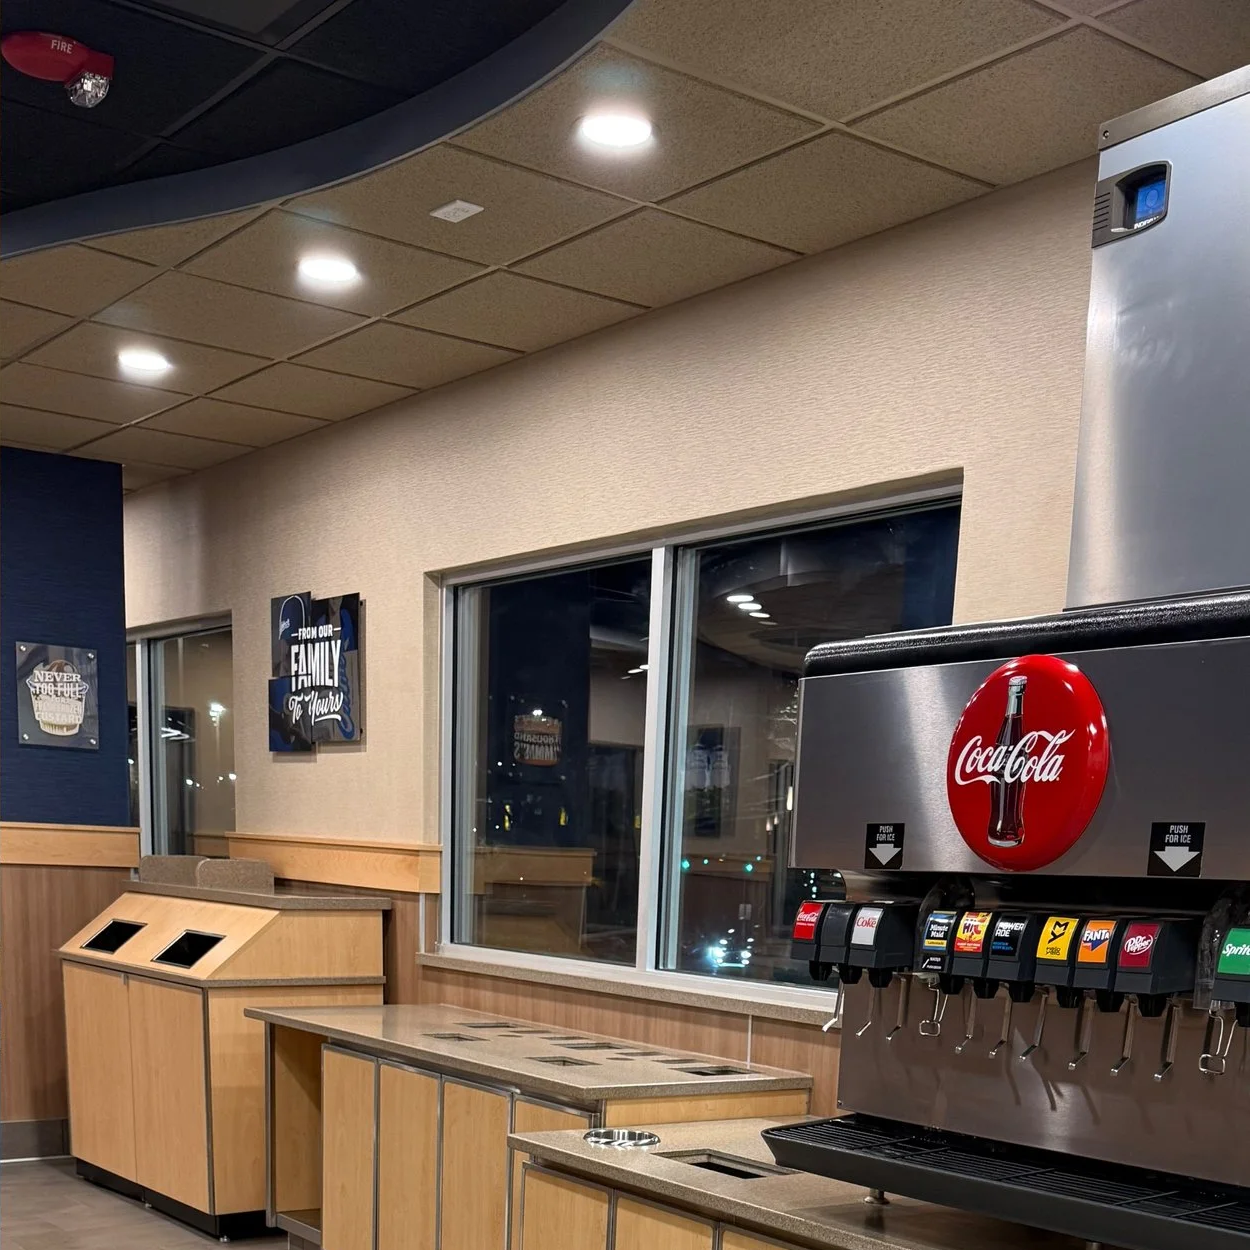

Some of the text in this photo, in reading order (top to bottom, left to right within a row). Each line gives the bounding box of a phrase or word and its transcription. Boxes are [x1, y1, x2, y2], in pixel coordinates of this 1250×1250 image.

[51, 39, 74, 54] FIRE
[298, 626, 318, 640] FROM
[318, 624, 333, 638] OUR
[290, 640, 342, 692] FAMILY
[34, 670, 82, 682] NEVER
[34, 682, 82, 698] TOO FULL
[289, 690, 344, 726] To Yours
[954, 728, 1077, 786] Coca-Cola
[1170, 825, 1189, 834] PUSH
[1165, 834, 1192, 843] FOR ICE
[856, 916, 877, 928] Coke
